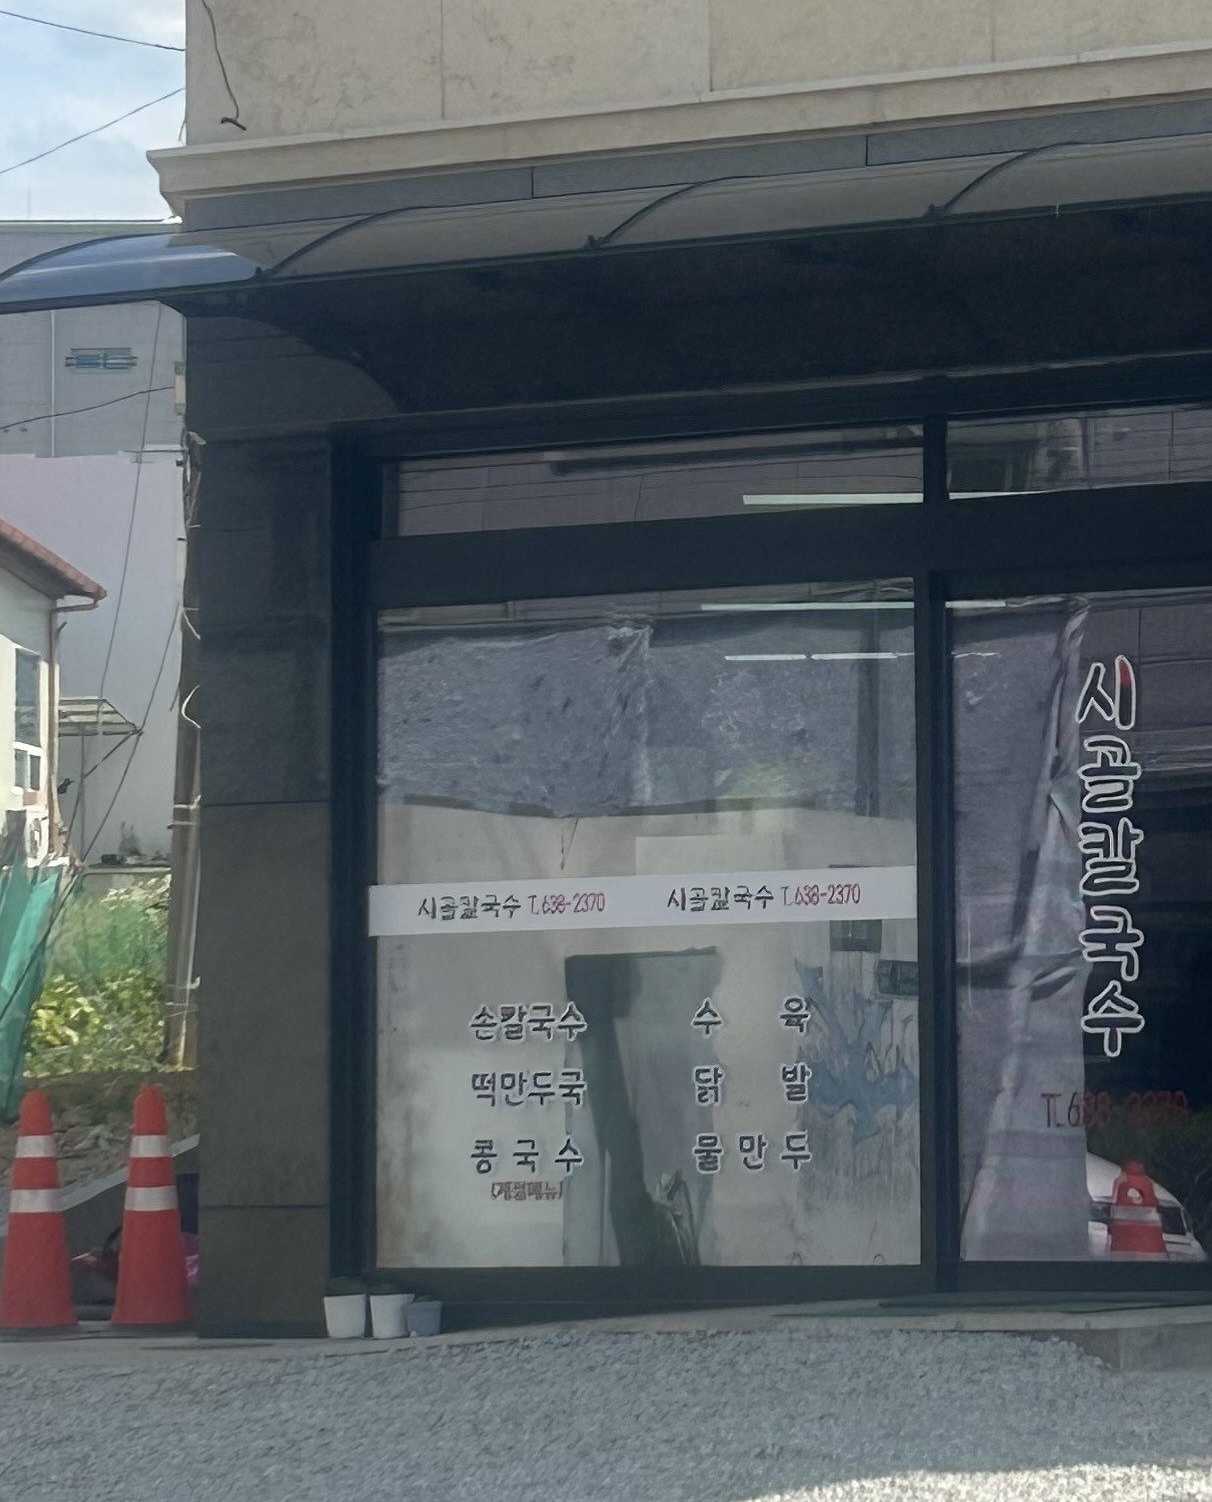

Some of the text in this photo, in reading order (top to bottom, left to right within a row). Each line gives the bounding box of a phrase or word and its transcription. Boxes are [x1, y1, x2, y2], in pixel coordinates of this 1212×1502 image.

[1075, 654, 1144, 1058] 시골칼국수
[418, 894, 522, 921] 시골칼국수
[667, 885, 774, 912] 시골칼국수
[470, 1001, 587, 1042] 손칼국수
[471, 1067, 587, 1107] 떡만두국
